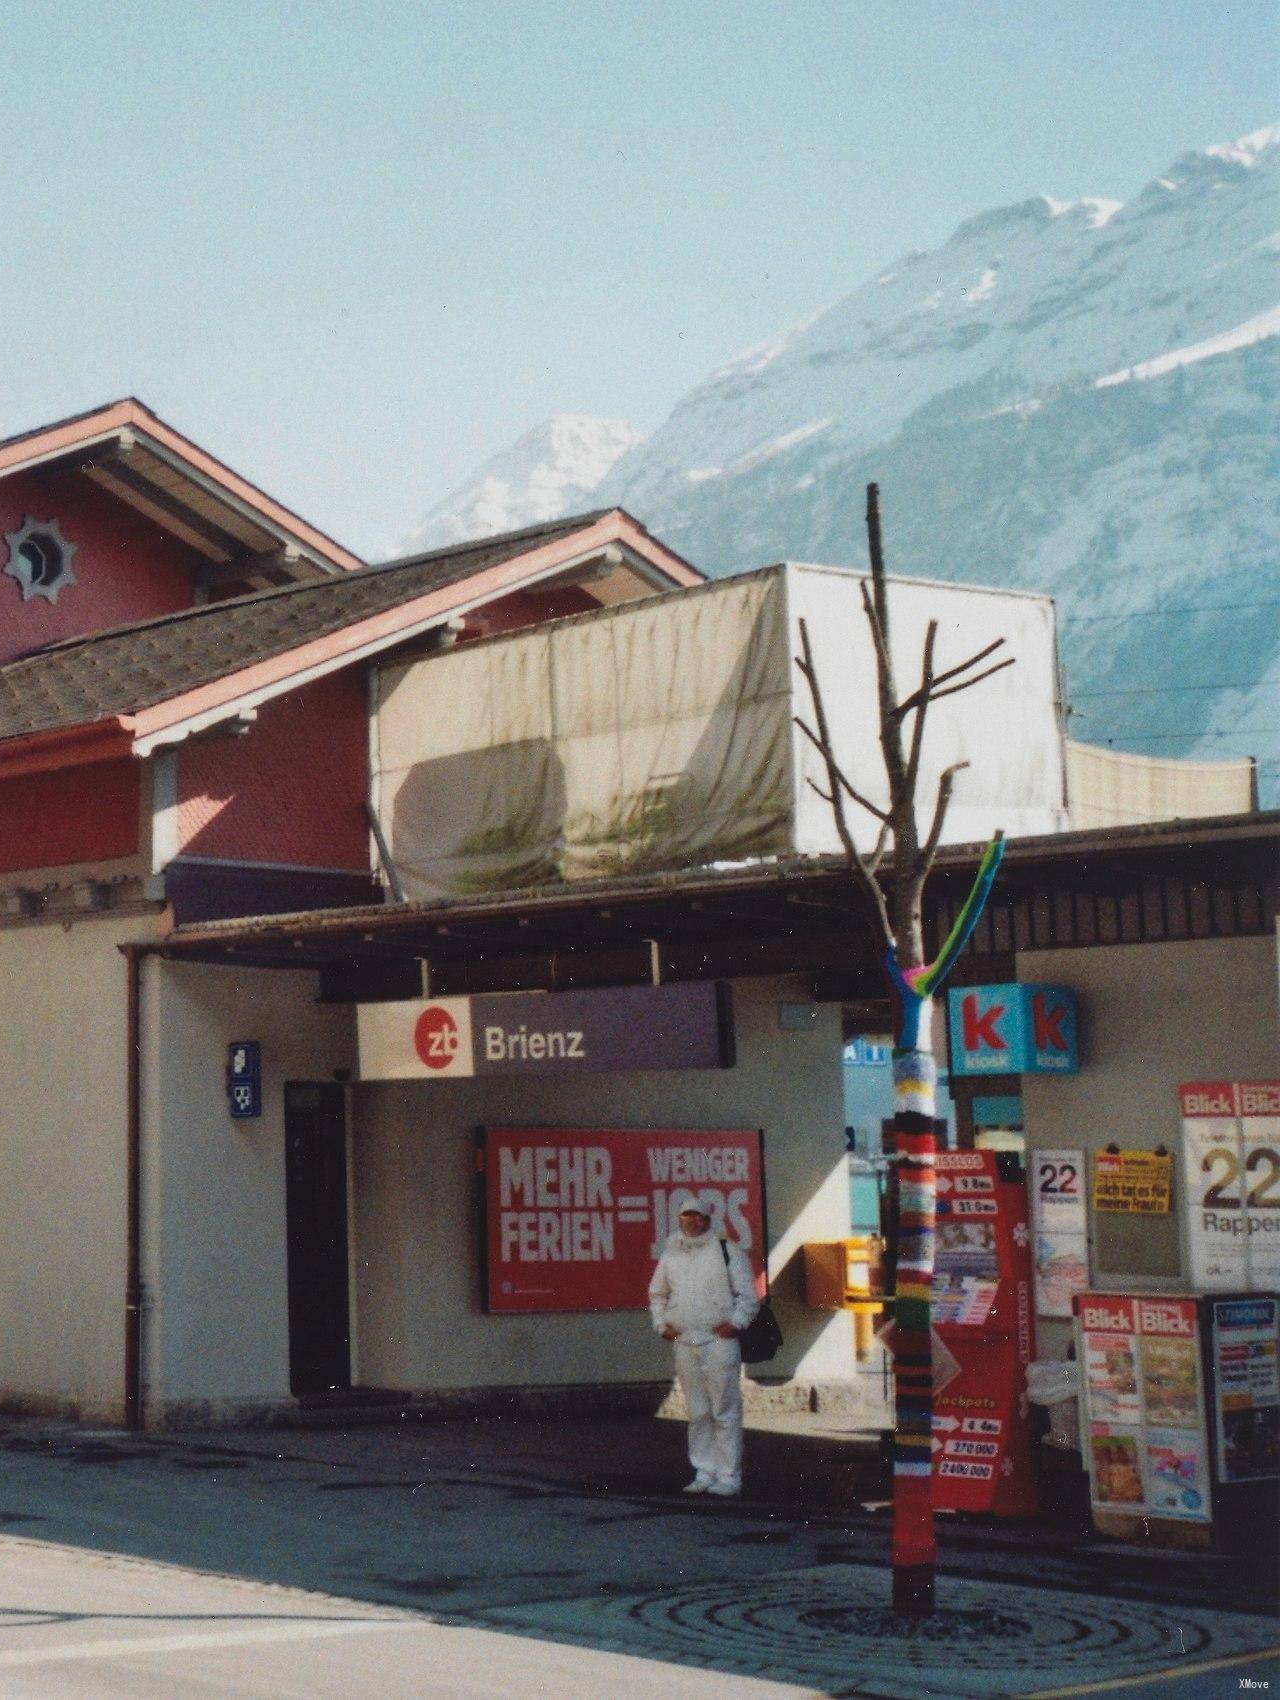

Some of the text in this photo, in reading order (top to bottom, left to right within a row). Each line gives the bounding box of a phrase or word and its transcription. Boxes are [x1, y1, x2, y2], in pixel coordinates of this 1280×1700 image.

[428, 1023, 458, 1057] zb
[485, 1025, 585, 1060] Brienz
[1184, 1094, 1232, 1114] Blick
[1243, 1093, 1280, 1112] Blic
[498, 1146, 615, 1208] MEHR
[646, 1147, 750, 1182] WENIGER
[1040, 1164, 1077, 1193] 22
[499, 1211, 615, 1262] FERIEN
[1083, 1307, 1132, 1330] Blick
[1142, 1309, 1191, 1333] Blick
